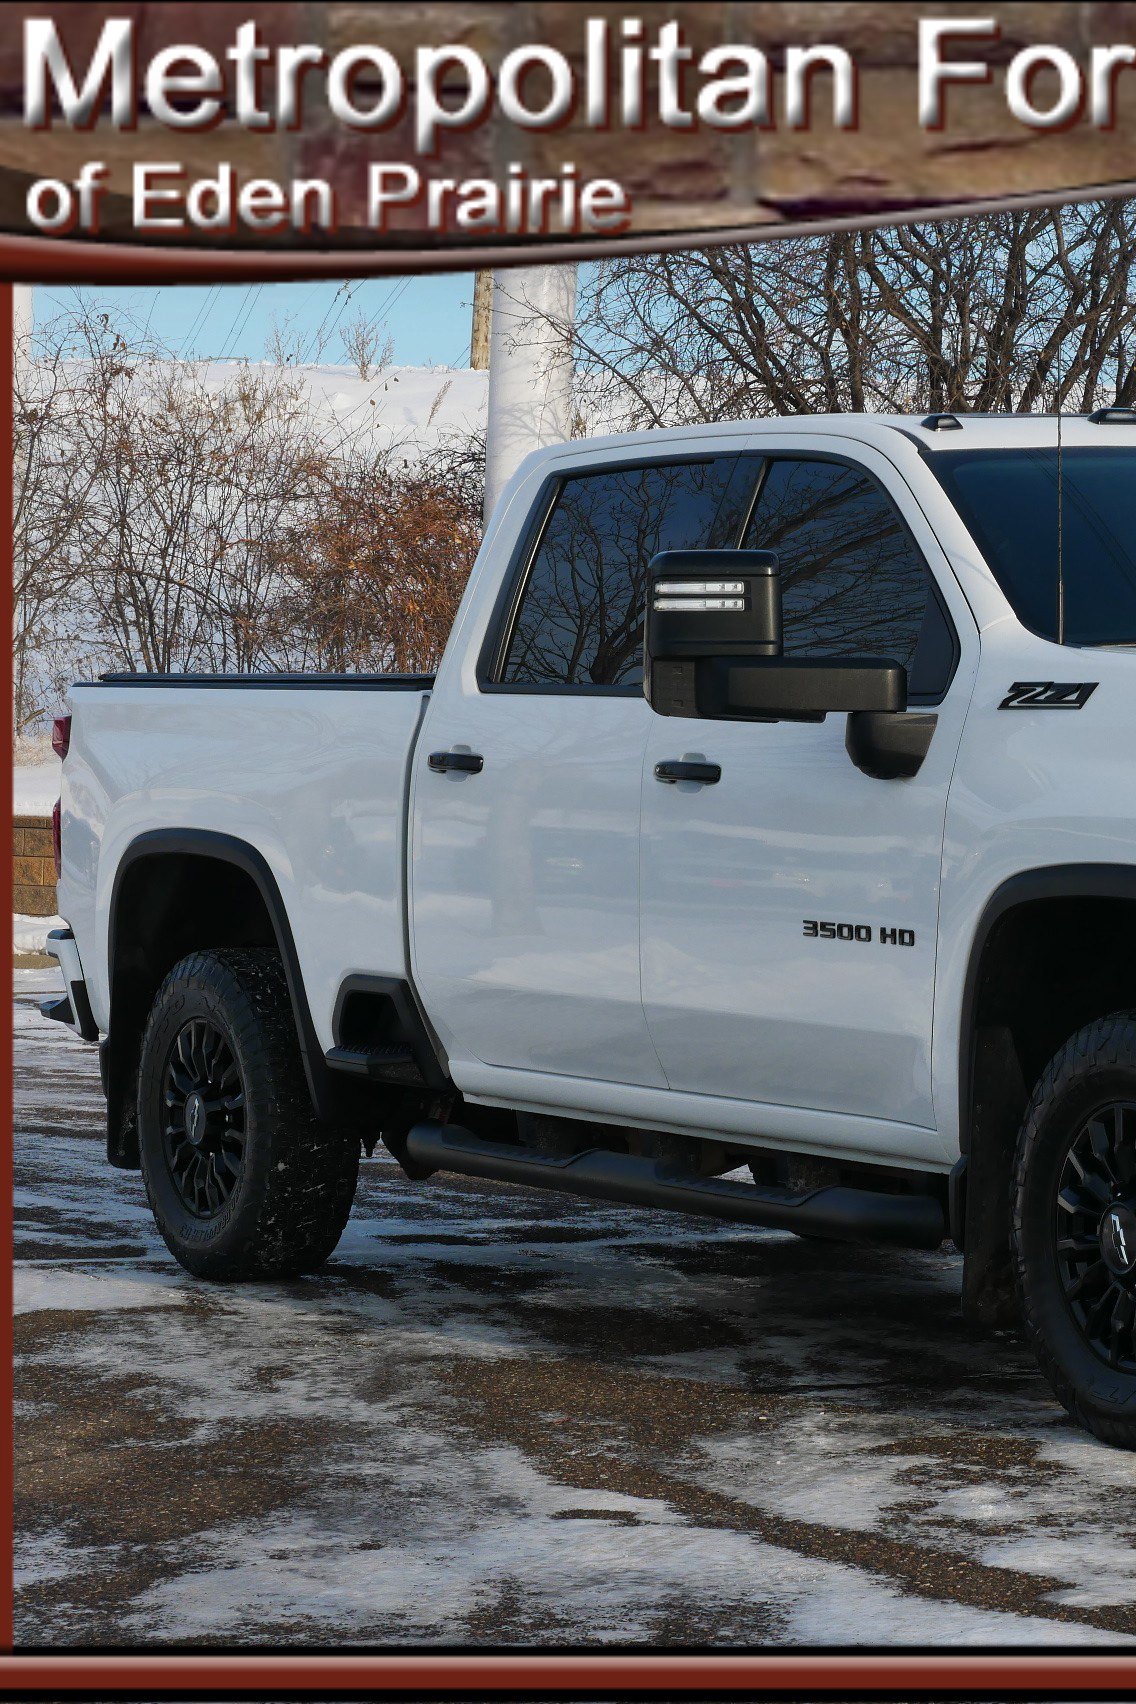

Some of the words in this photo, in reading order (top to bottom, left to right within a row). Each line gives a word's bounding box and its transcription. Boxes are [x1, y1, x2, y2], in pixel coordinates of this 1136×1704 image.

[997, 681, 1100, 710] Z71
[802, 919, 872, 943] 3500
[879, 926, 915, 947] HD
